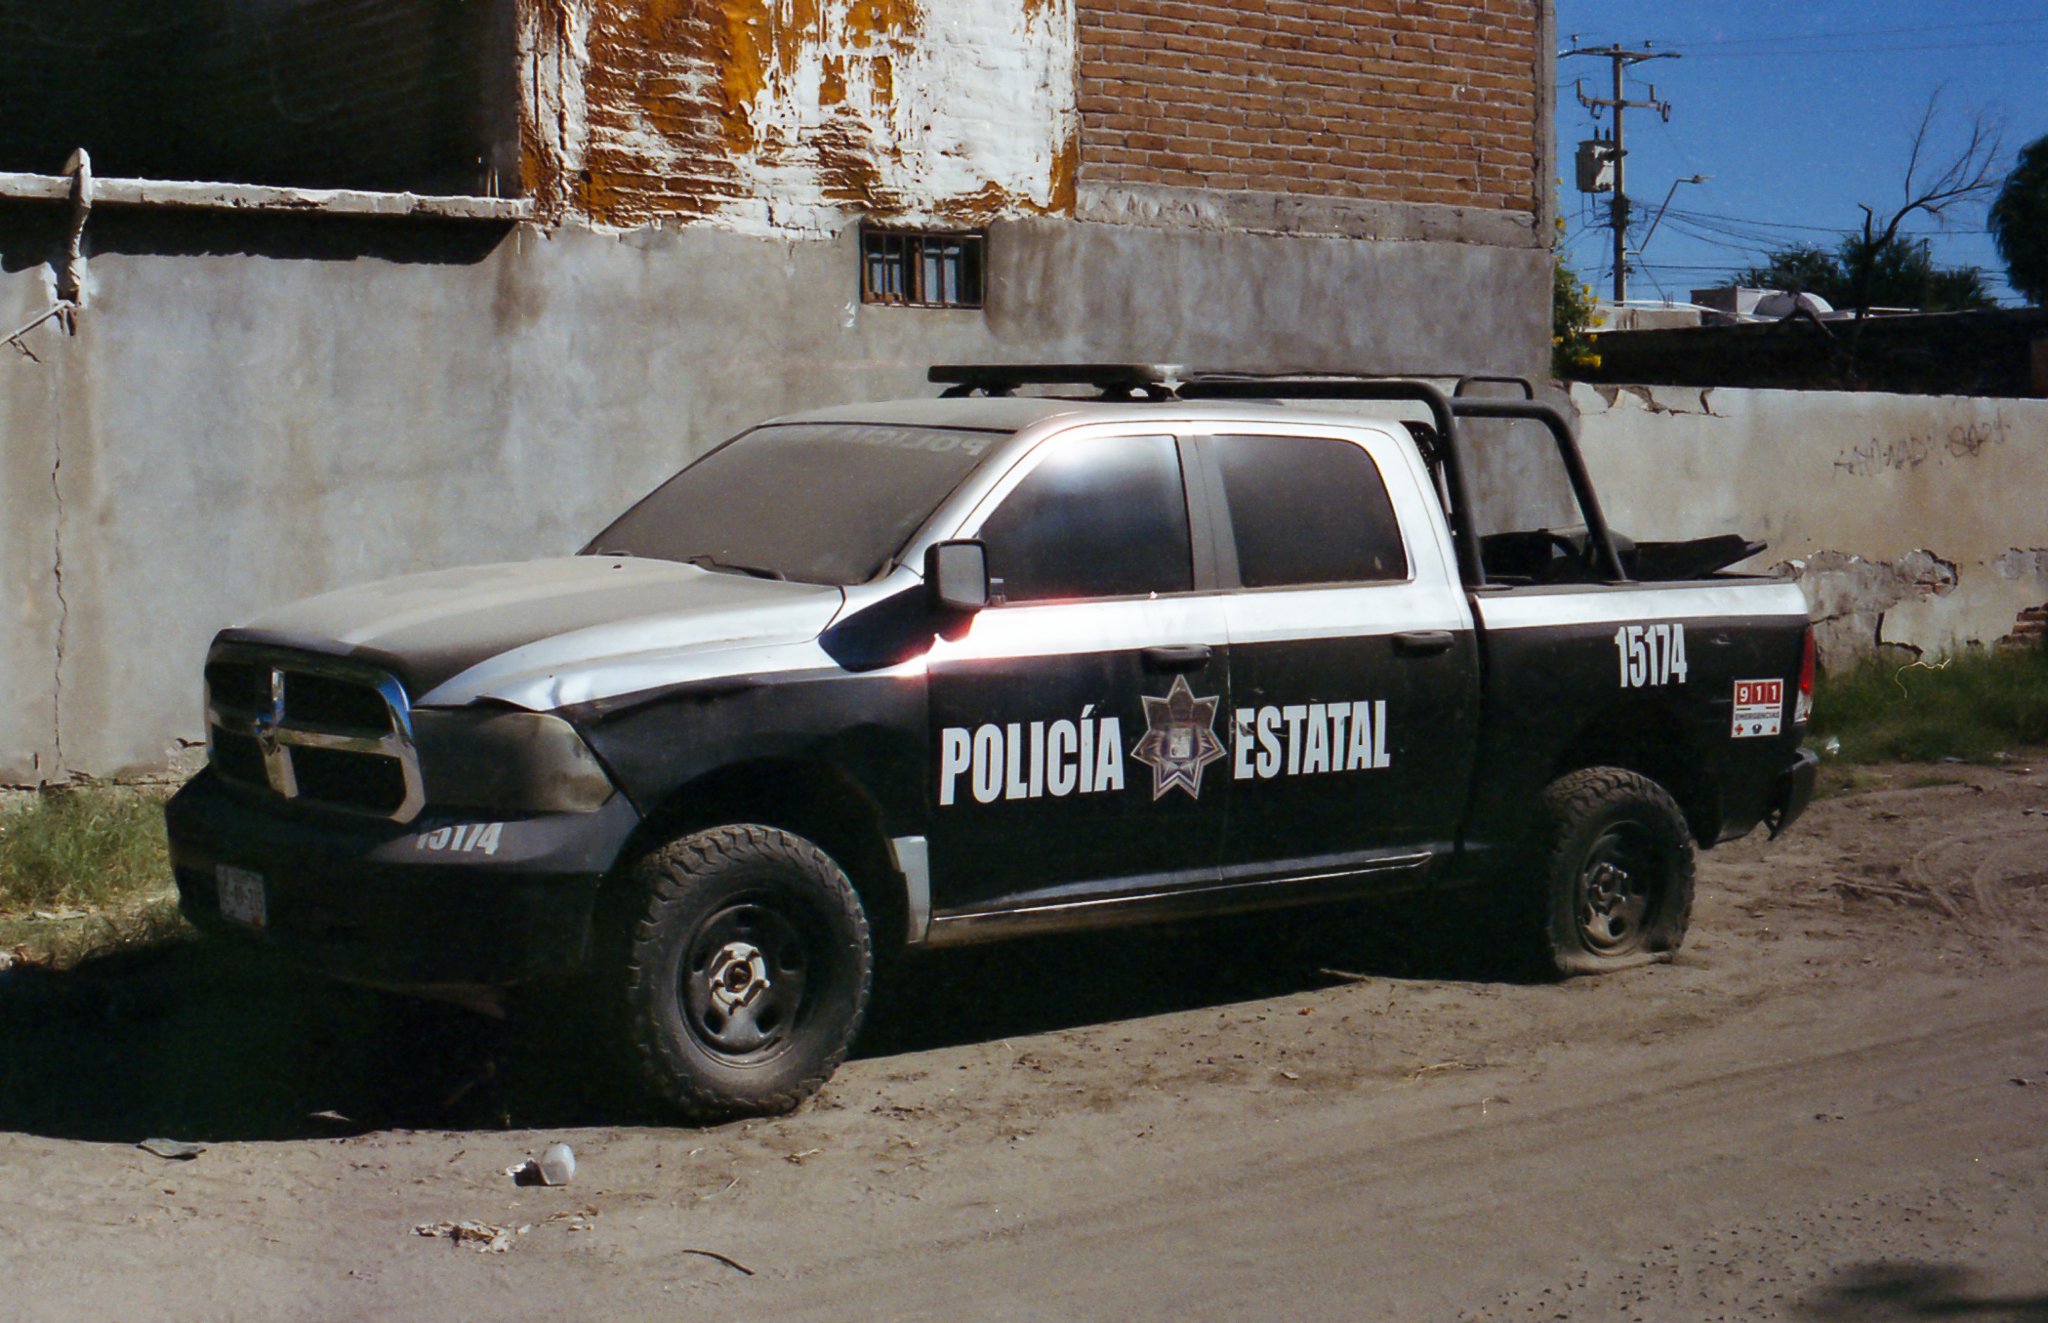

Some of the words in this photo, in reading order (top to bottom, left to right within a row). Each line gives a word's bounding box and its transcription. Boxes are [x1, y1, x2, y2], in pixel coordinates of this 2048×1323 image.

[1614, 623, 1688, 688] 15174
[1740, 685, 1777, 702] 911
[939, 704, 1125, 806] POLICÍA
[1233, 700, 1391, 780] ESTATAL
